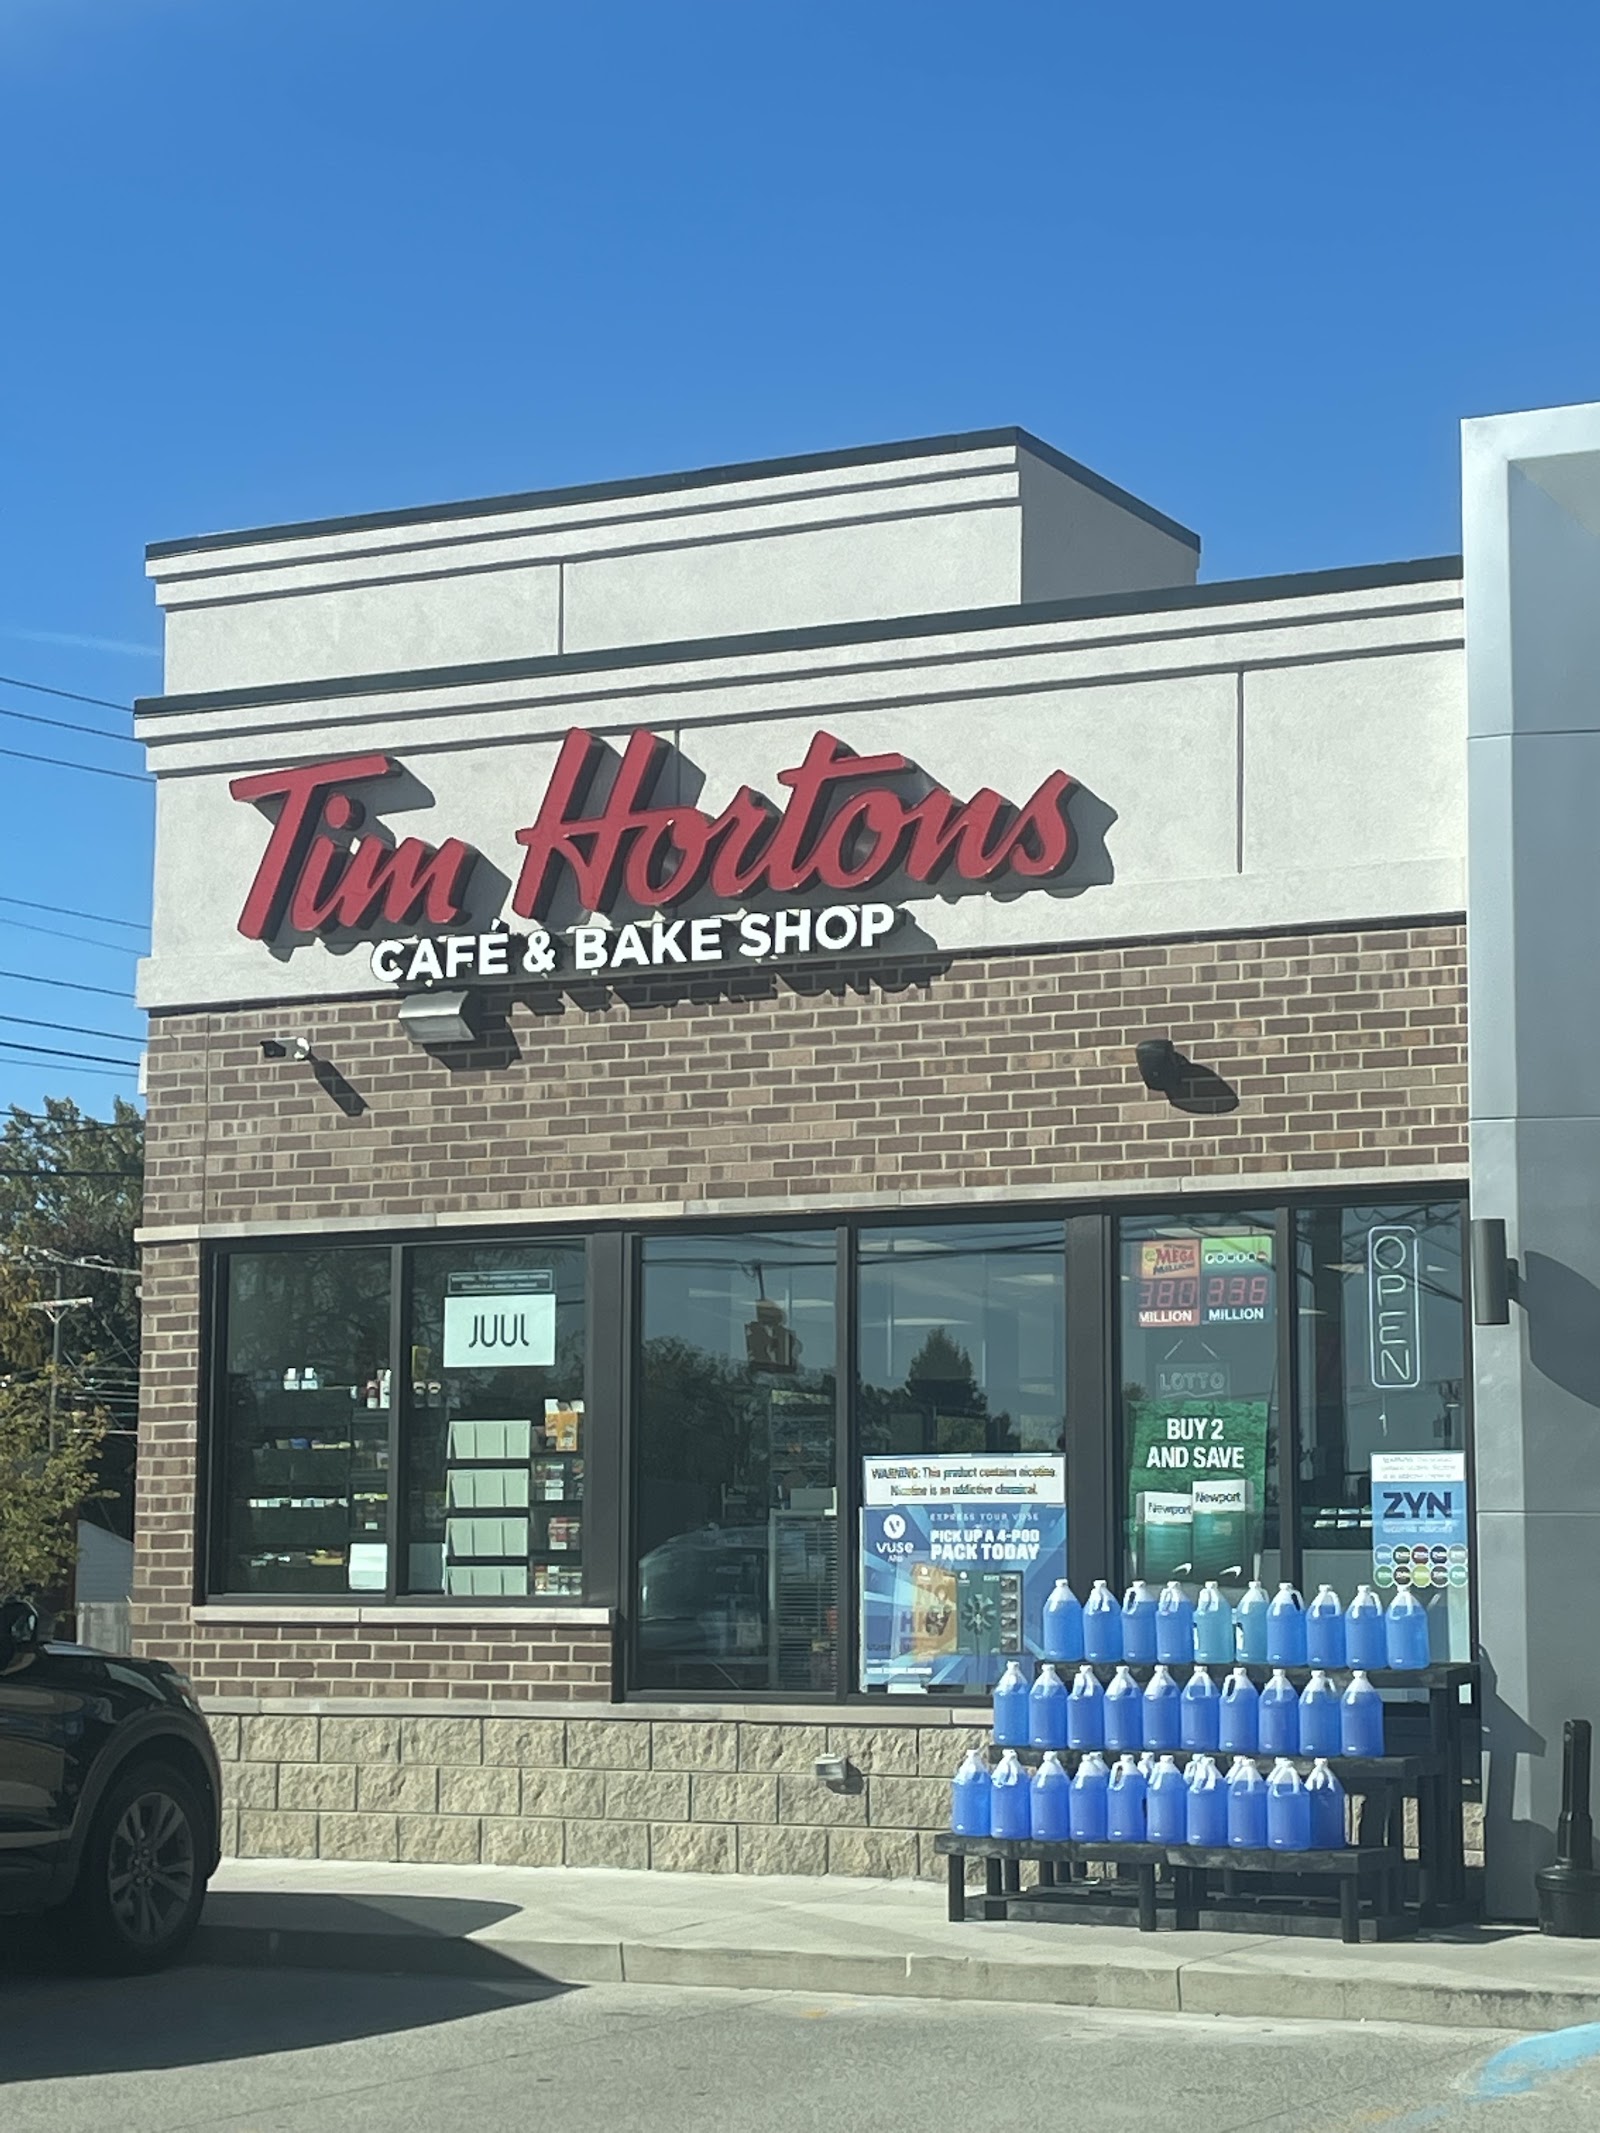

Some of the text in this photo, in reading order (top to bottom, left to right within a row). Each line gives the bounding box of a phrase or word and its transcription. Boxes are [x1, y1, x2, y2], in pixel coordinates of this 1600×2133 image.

[229, 727, 1085, 940] Tim Hortons
[370, 902, 895, 982] CAFÉ & BAKE SHOP
[1156, 1247, 1195, 1264] MEGA
[1139, 1307, 1264, 1322] MILLION MILLION
[1373, 1235, 1410, 1380] OPEN
[468, 1313, 530, 1348] JUUL
[1160, 1372, 1225, 1391] LOTTO
[1167, 1418, 1224, 1440] BUY 2
[1146, 1446, 1245, 1468] AND SAVE
[923, 1466, 941, 1478] This
[944, 1465, 977, 1481] product
[979, 1466, 1017, 1478] contains
[930, 1483, 938, 1496] is
[953, 1483, 993, 1496] addictive
[1195, 1491, 1242, 1504] Newport
[1148, 1502, 1192, 1516] Newport
[1383, 1491, 1453, 1518] ZYN
[930, 1529, 1040, 1543] PICK UP A 4-POD
[930, 1543, 1040, 1560] PACK TODAY
